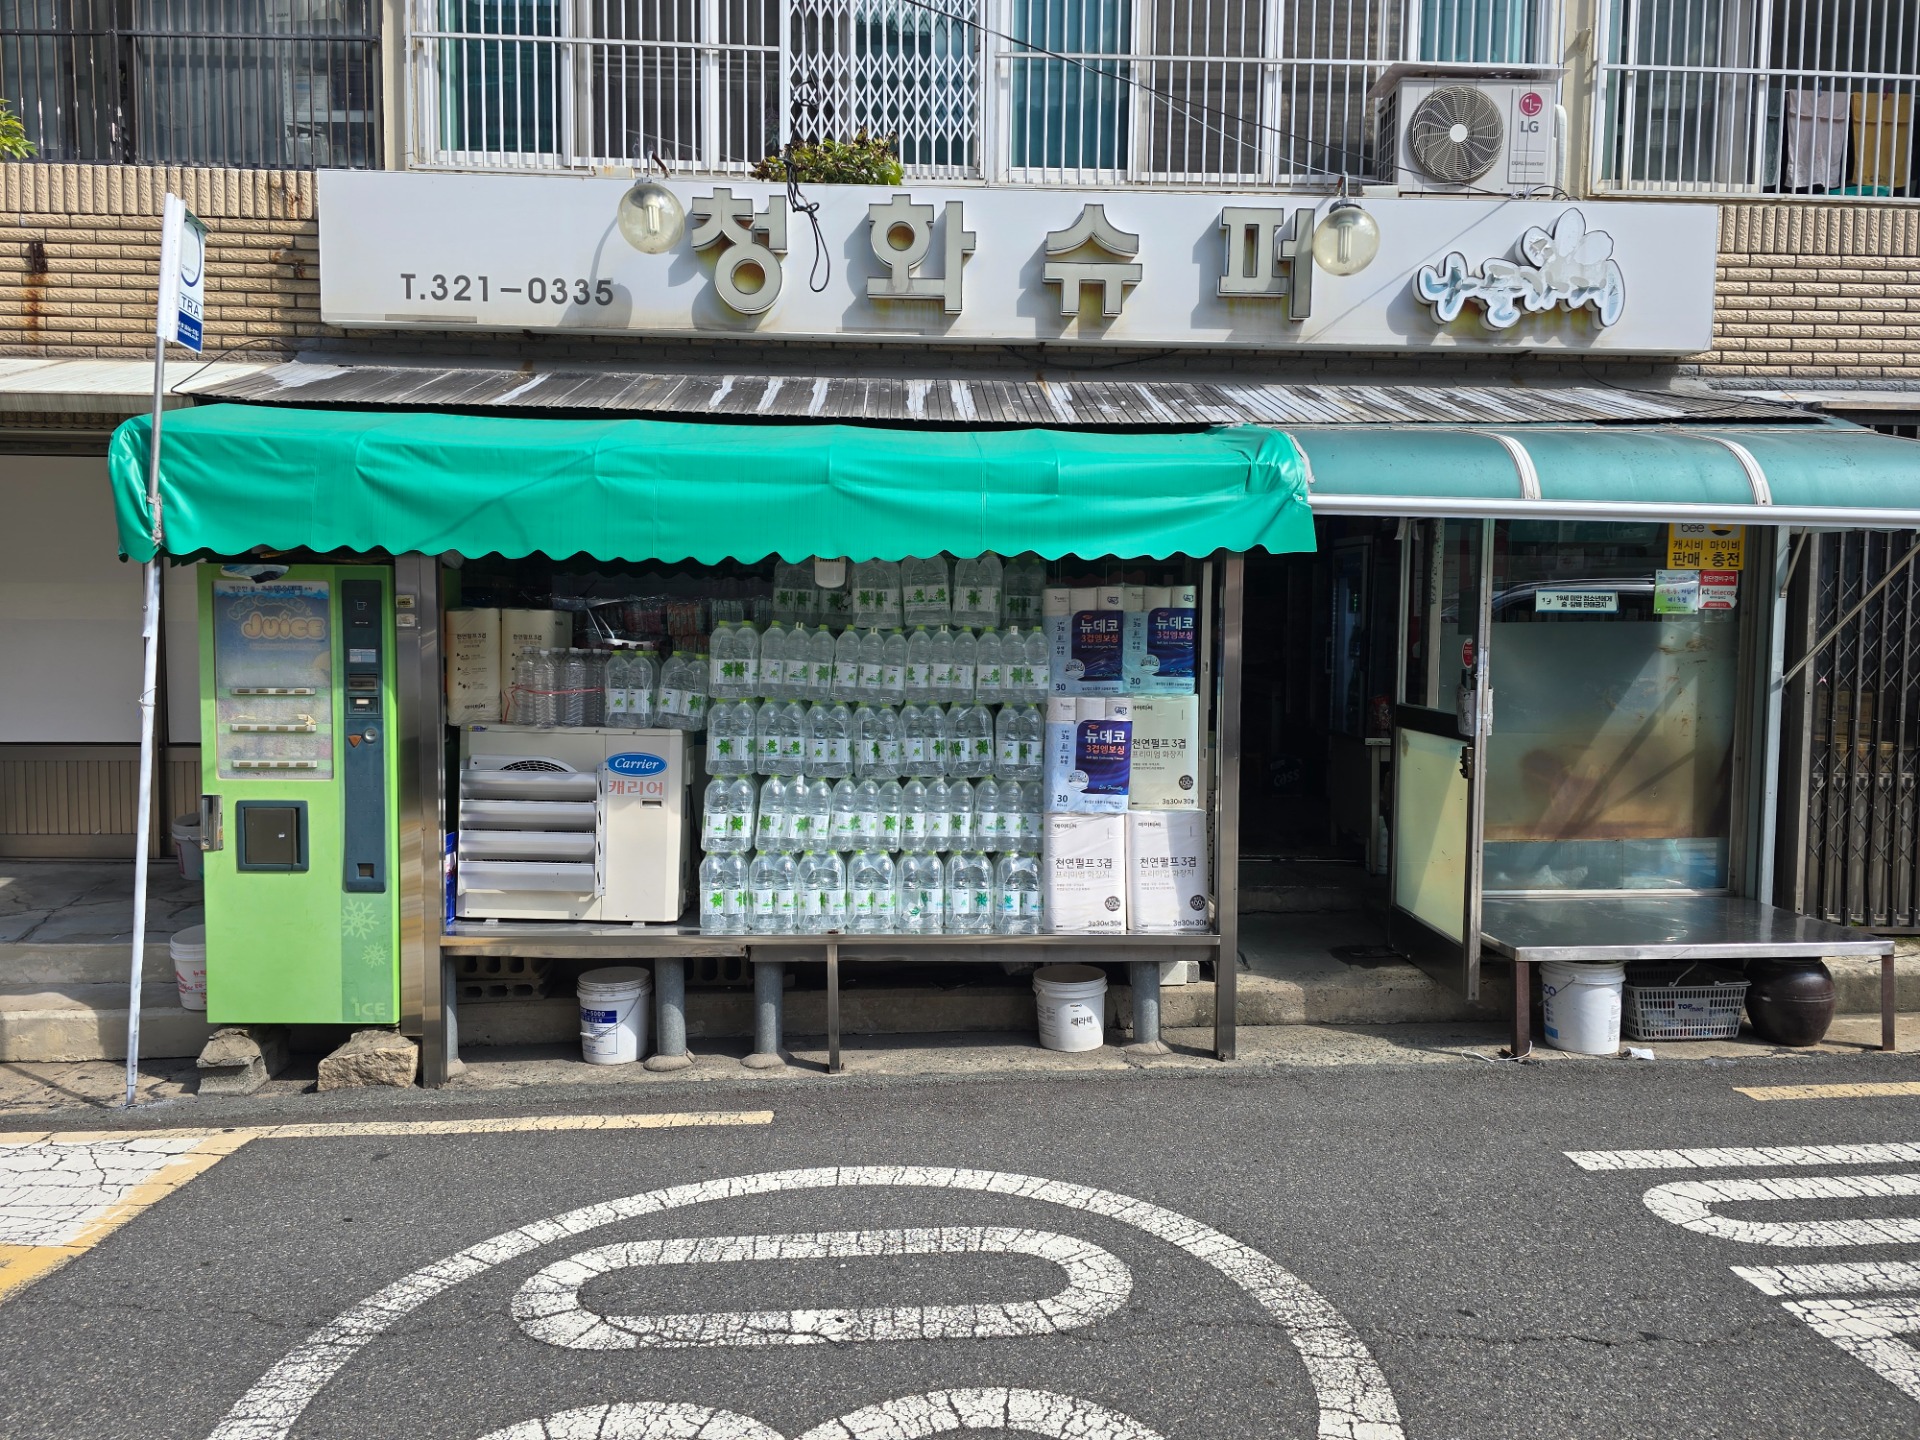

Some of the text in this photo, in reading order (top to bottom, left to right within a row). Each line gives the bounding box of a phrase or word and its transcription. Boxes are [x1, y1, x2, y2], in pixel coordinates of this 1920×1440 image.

[1520, 120, 1540, 134] LG
[1673, 540, 1740, 550] 캐시비 마이비
[1672, 552, 1700, 567] 판매
[1711, 552, 1740, 567] 충전
[1702, 587, 1735, 597] kt telecop
[1080, 619, 1119, 633] 뉴데코
[1156, 616, 1194, 630] 뉴데코
[1081, 634, 1119, 643] 3겹엠보싱
[1157, 631, 1193, 640] 3겹엠보싱
[1056, 683, 1066, 691] 30
[1085, 729, 1126, 744] 뉴데코
[1086, 744, 1125, 755] 3겹엠보싱
[1132, 738, 1187, 750] 천연펄프 3겹
[1132, 750, 1184, 759] 프리미엄 화장지
[615, 758, 659, 770] Carrier
[608, 780, 663, 796] 캐리어
[1057, 794, 1068, 803] 30
[1056, 857, 1112, 869] 천연펄프 3겹
[1140, 856, 1197, 868] 천연펄프 3겹
[1056, 870, 1109, 878] 프리미엄 화장지
[1140, 869, 1194, 878] 프리미엄 화장지
